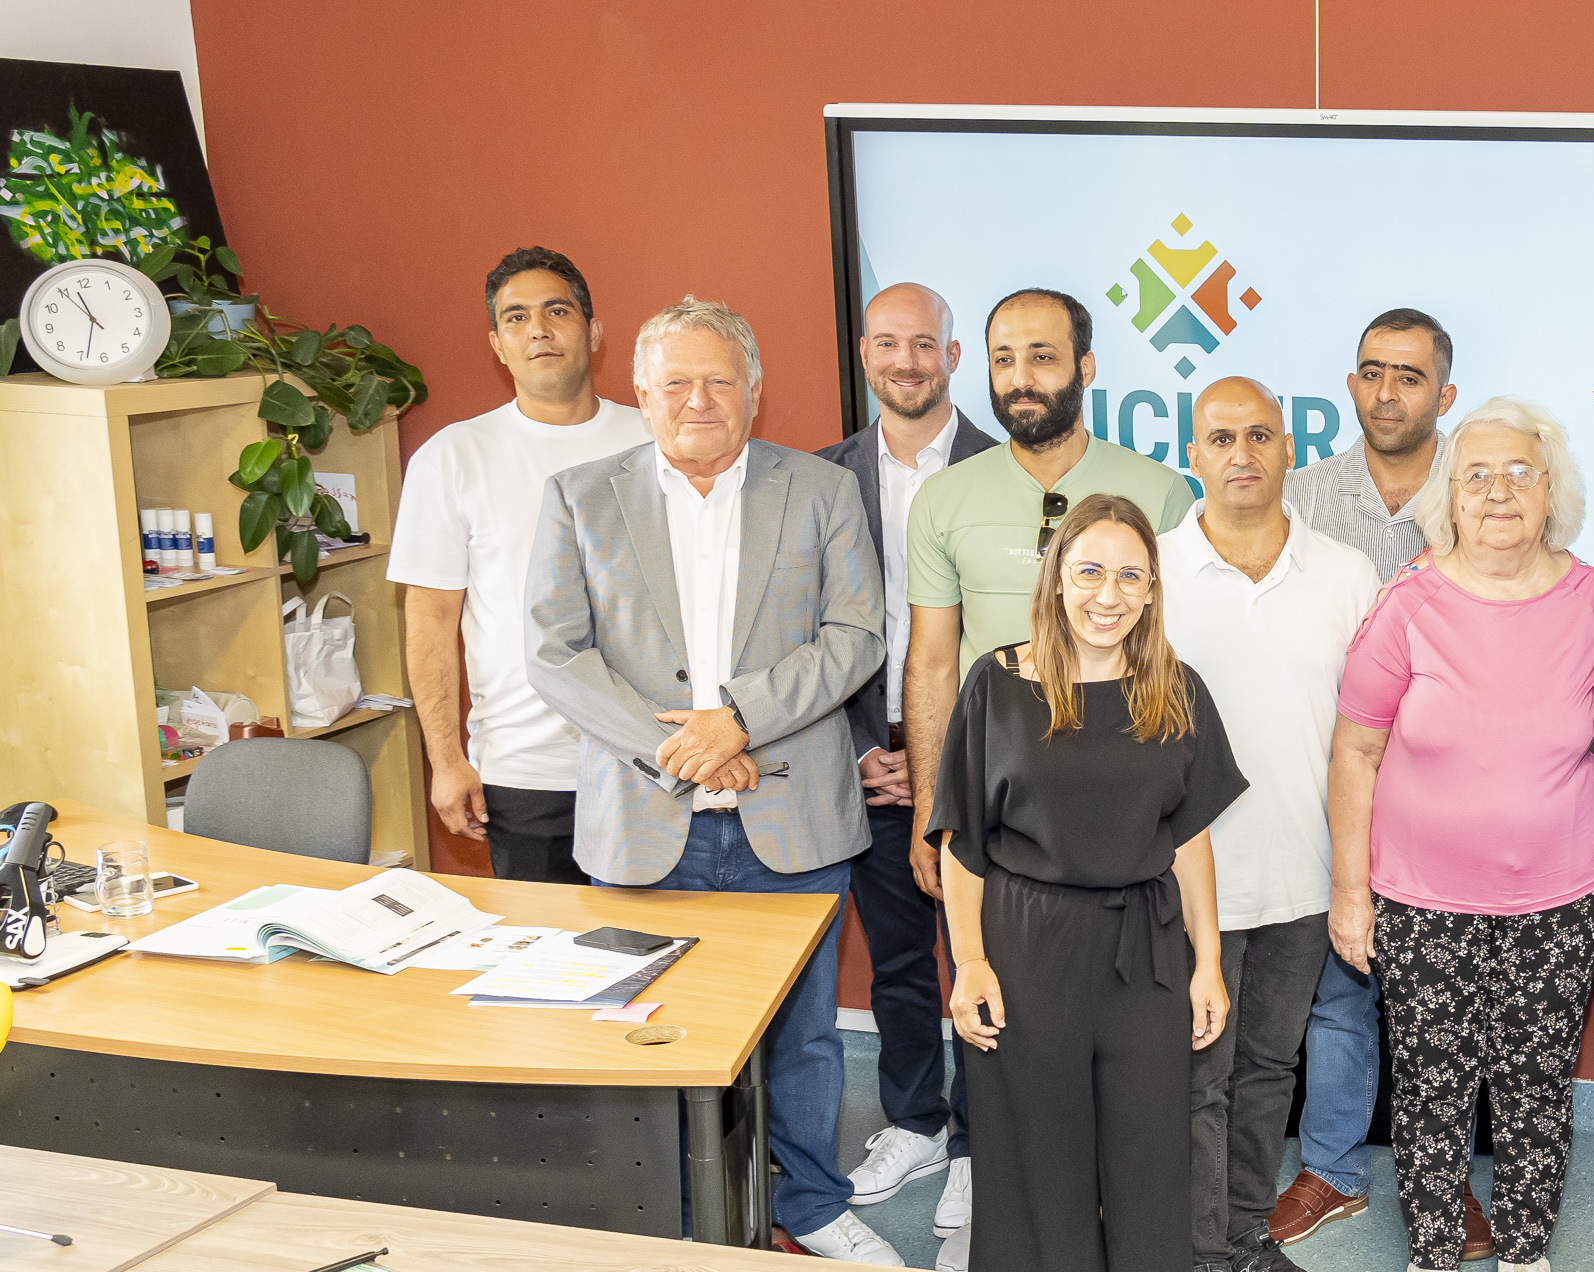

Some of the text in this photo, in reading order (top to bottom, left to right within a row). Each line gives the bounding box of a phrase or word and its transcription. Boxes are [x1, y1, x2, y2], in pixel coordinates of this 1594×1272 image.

[77, 278, 91, 289] 12
[104, 280, 112, 290] 1
[57, 287, 70, 298] 11
[122, 289, 133, 300] 2
[45, 302, 59, 314] 10
[133, 307, 143, 318] 3
[45, 323, 54, 334] 9
[133, 327, 142, 337] 4
[56, 340, 65, 352] 8
[121, 342, 130, 353] 5
[76, 350, 85, 361] 7
[99, 352, 109, 363] 6
[5, 906, 30, 950] SAX
